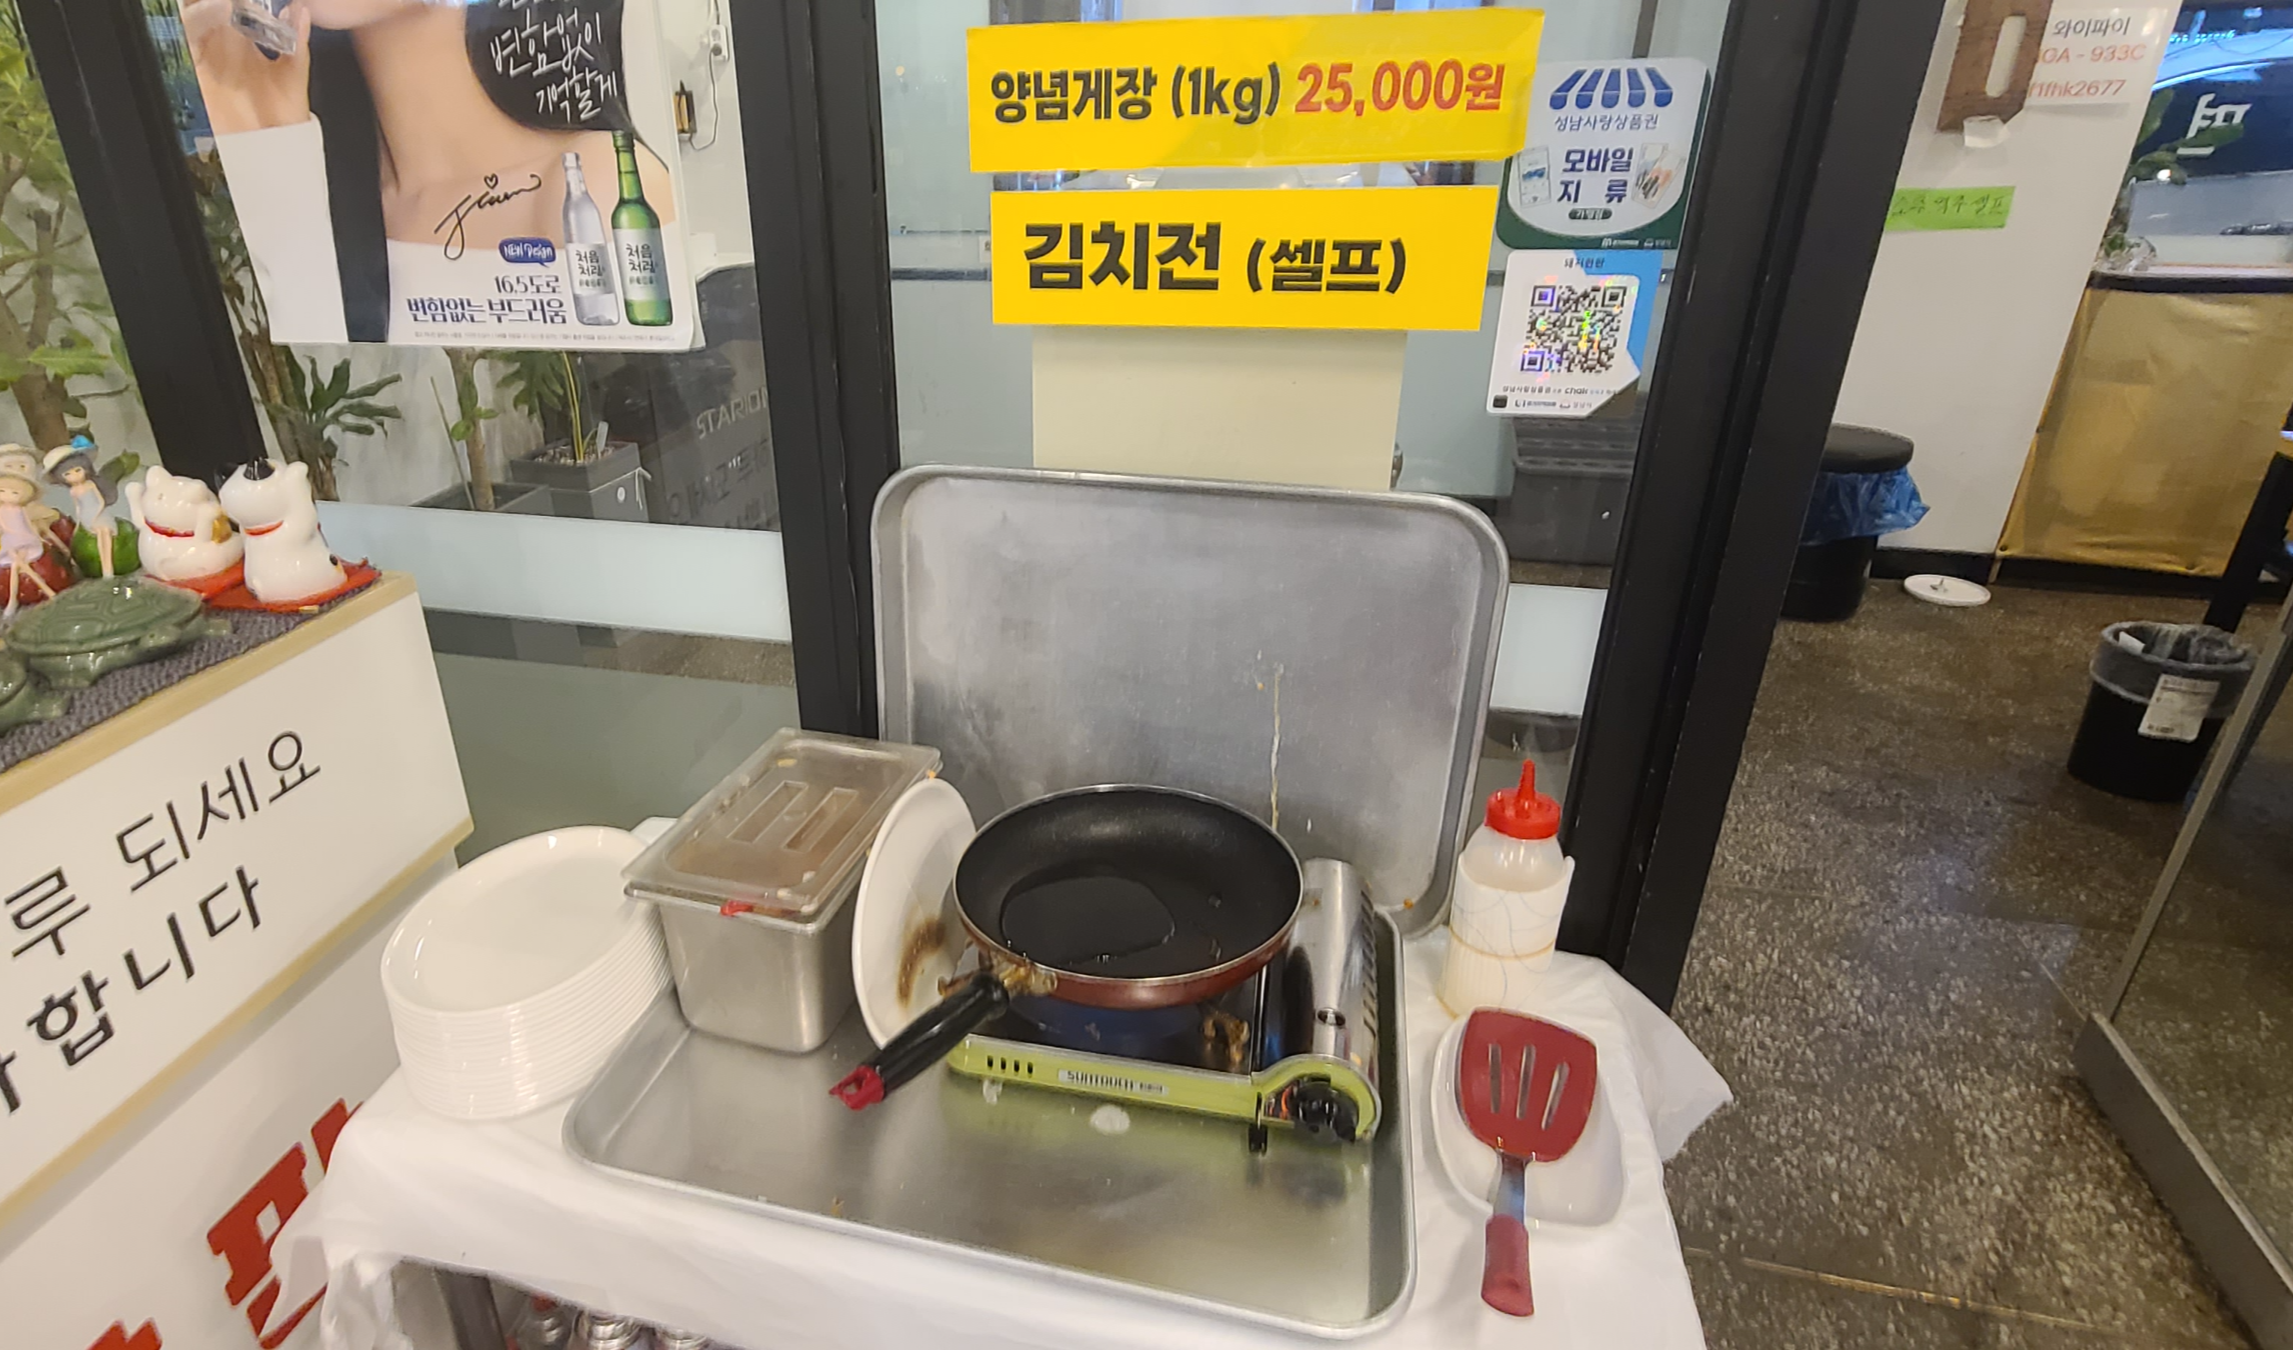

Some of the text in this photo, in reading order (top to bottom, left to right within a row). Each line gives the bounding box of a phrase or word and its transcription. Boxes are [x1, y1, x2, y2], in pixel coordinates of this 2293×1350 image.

[2052, 17, 2131, 38] 와이파이
[490, 7, 602, 78] 변함없이
[536, 65, 618, 123] 기억할게
[991, 58, 1505, 125] 양념게장 (1kg) 25,000원
[1554, 114, 1660, 131] 성남사랑상품권
[1562, 147, 1634, 173] 모바일
[575, 250, 599, 264] 처음
[626, 243, 652, 259] 처음
[1023, 221, 1407, 294] 김치전 (셀프)
[578, 264, 603, 277] 처럼
[628, 259, 656, 274] 처럼
[495, 275, 562, 294] 16.5도로
[407, 297, 567, 324] 변함없는 부드러움
[116, 731, 321, 892] 되세요
